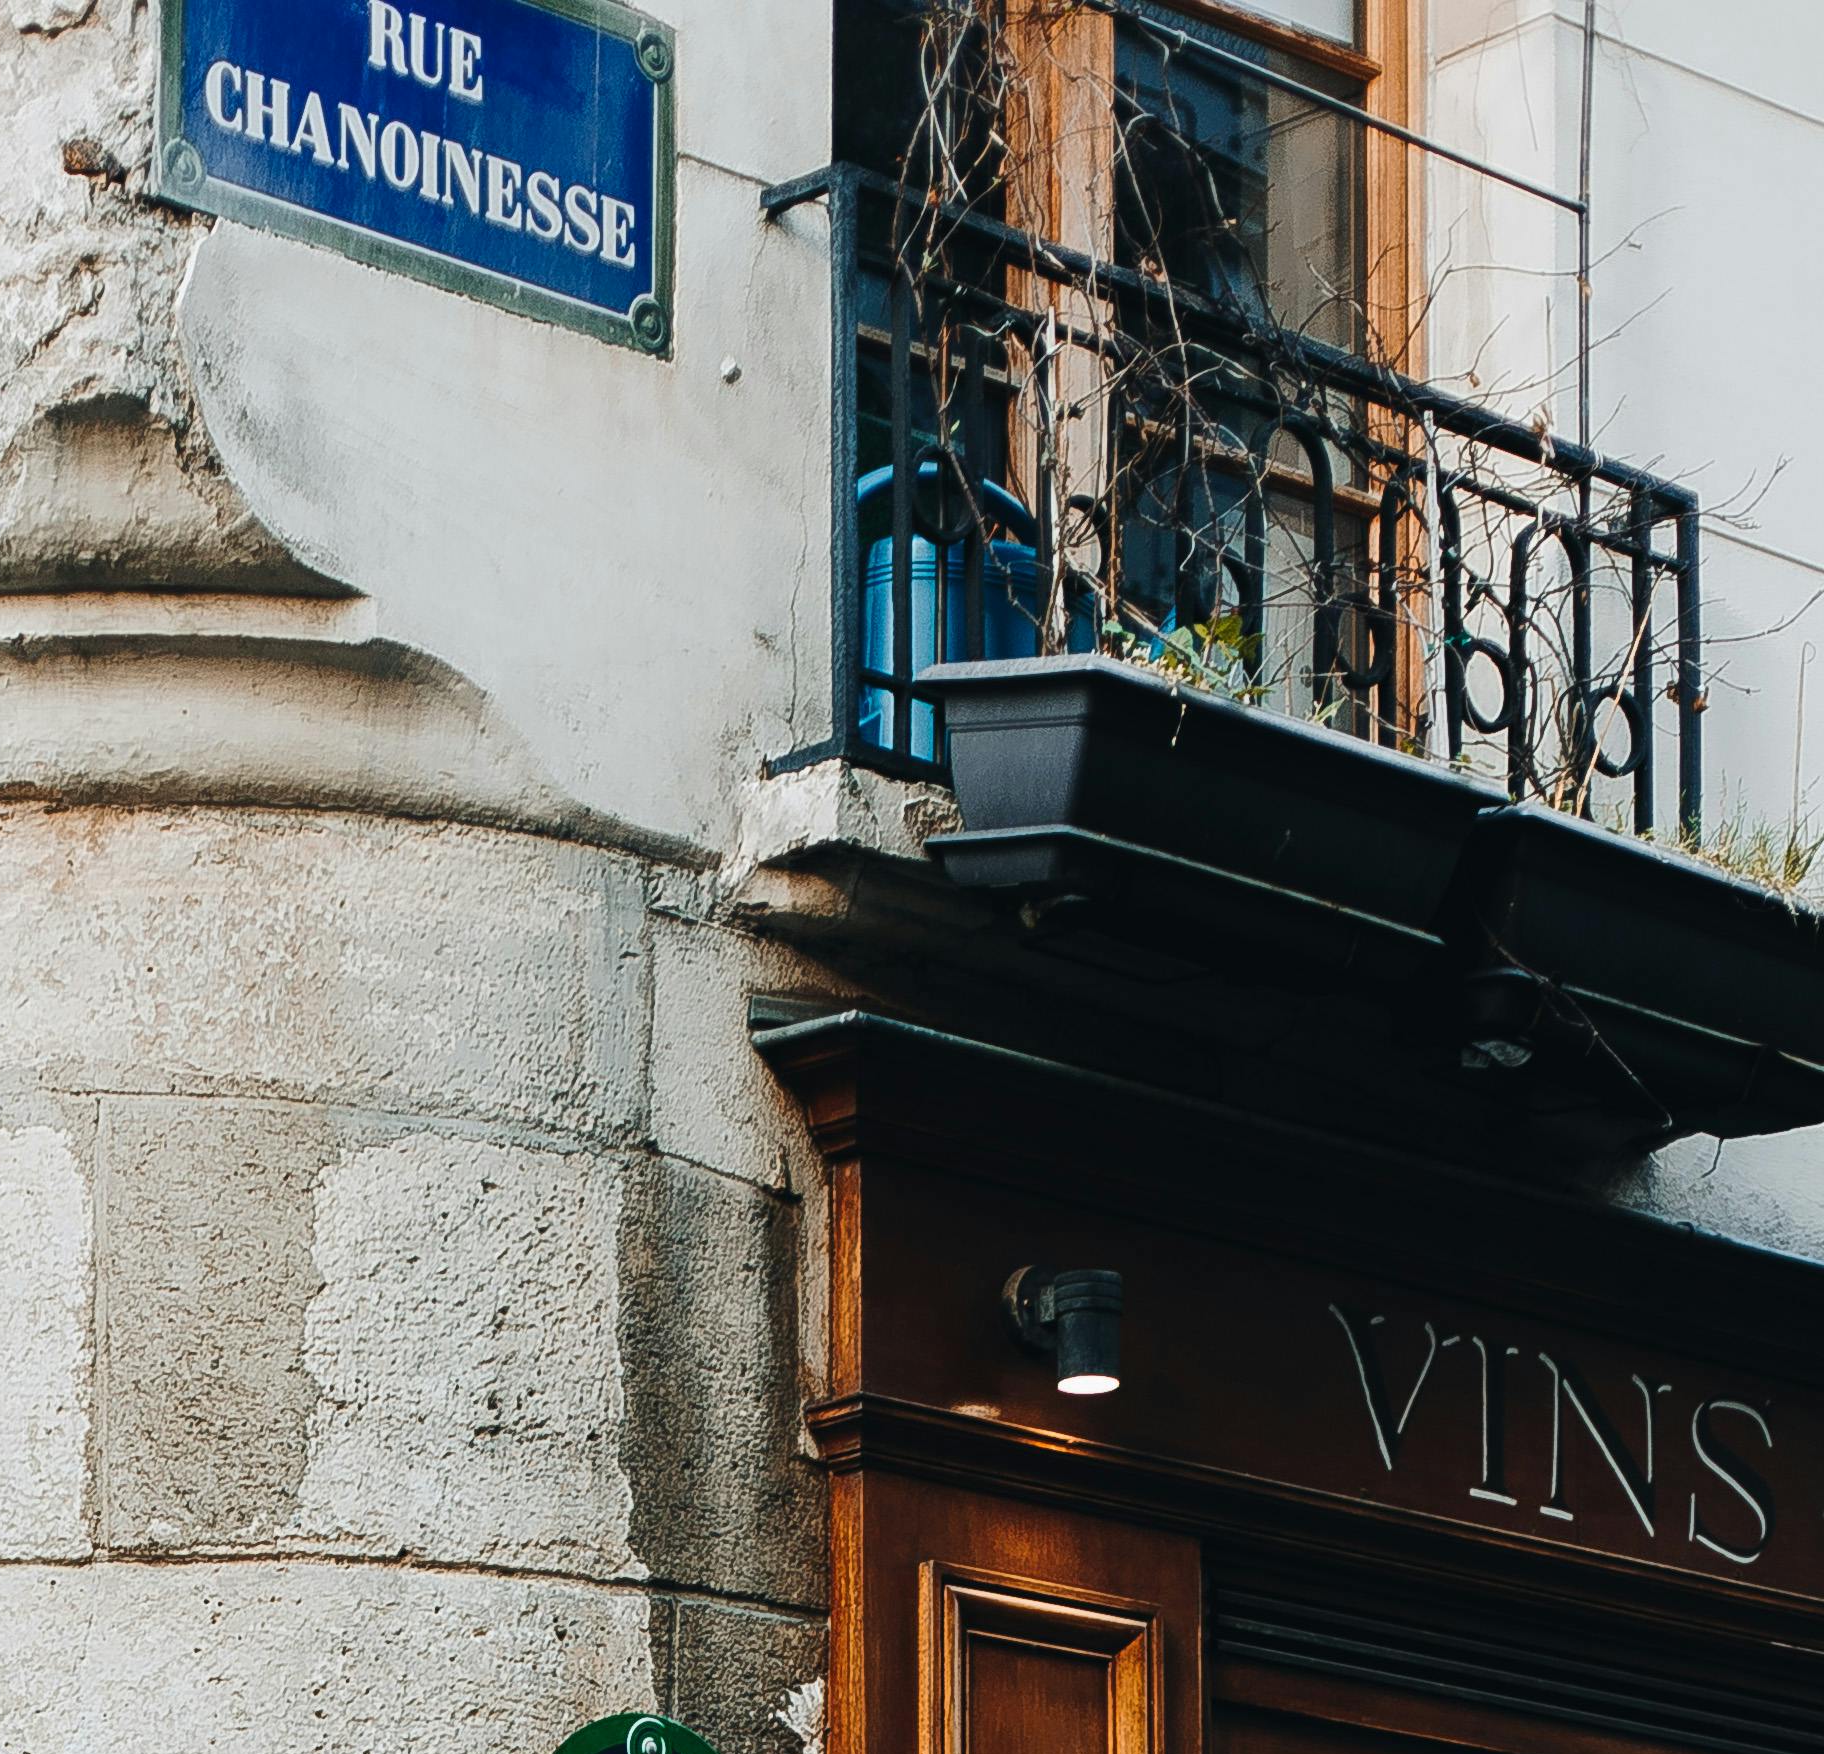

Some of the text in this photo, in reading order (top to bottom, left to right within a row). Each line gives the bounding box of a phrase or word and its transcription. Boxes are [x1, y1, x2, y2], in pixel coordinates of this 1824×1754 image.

[369, 0, 484, 102] RUE
[205, 60, 636, 269] CHANOINESSE
[1328, 1302, 1775, 1564] VINS
